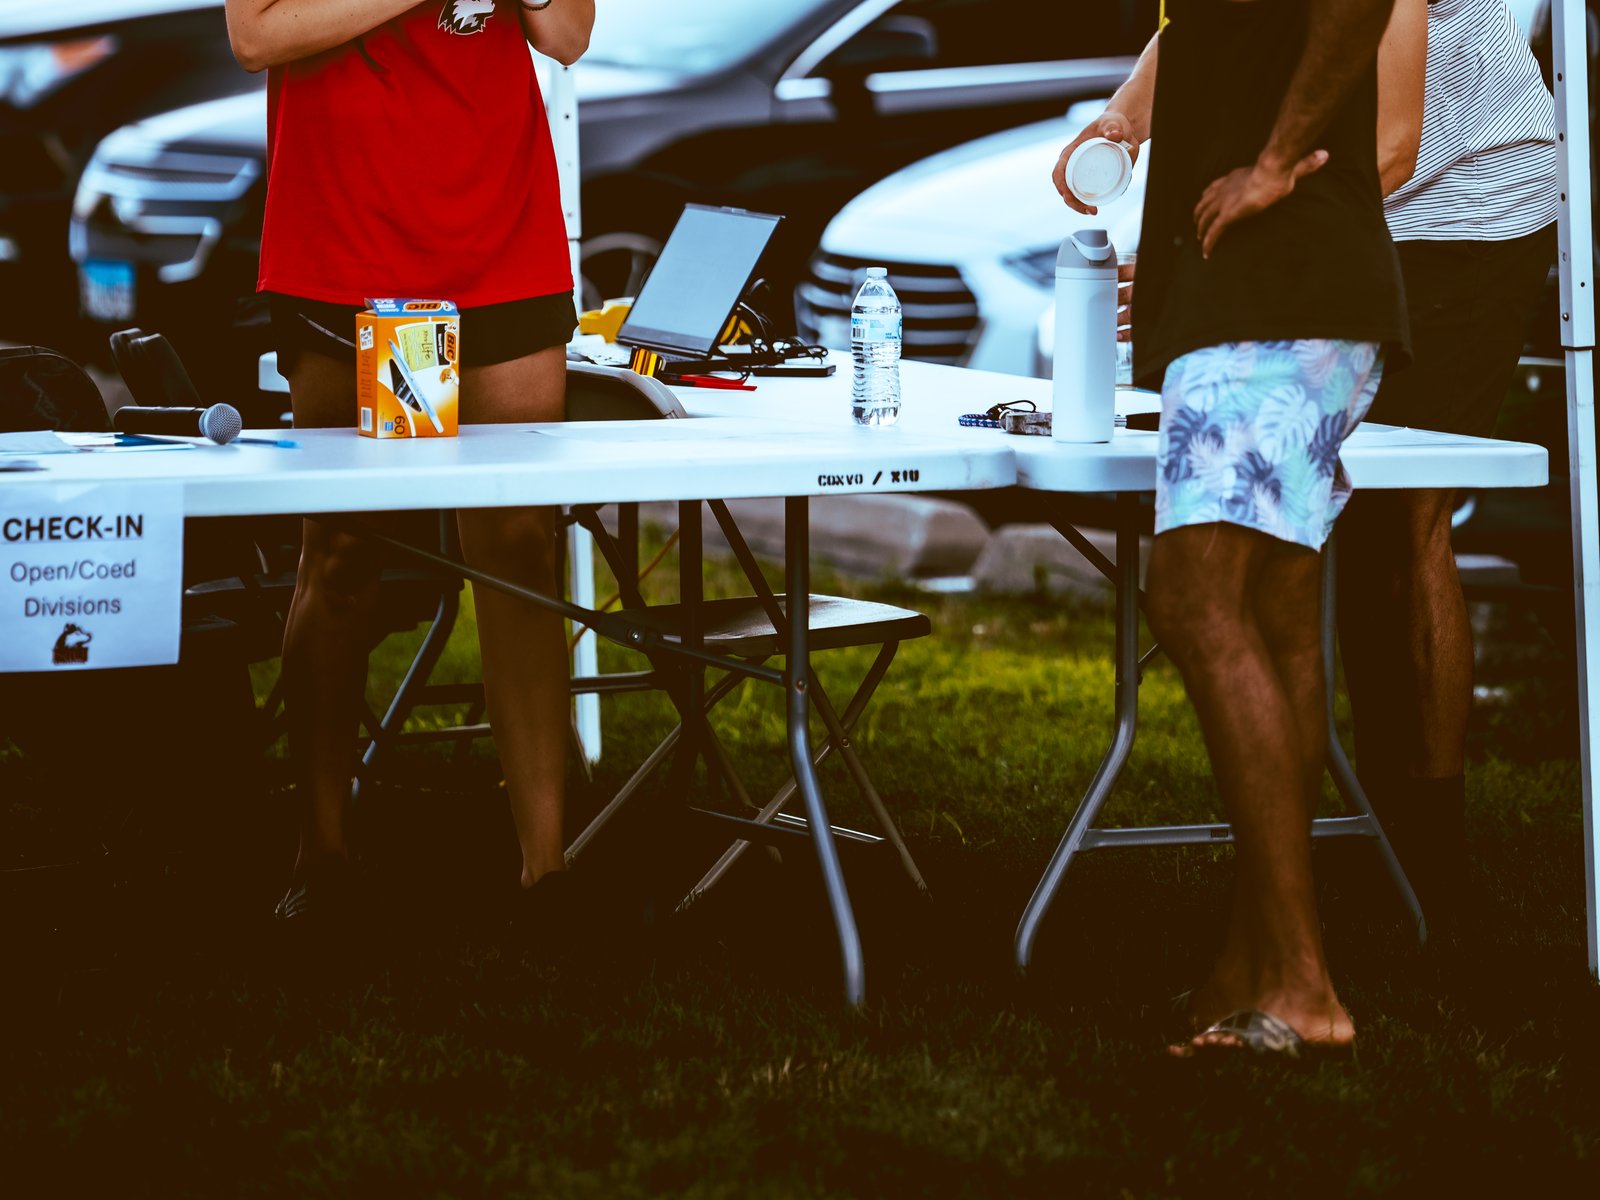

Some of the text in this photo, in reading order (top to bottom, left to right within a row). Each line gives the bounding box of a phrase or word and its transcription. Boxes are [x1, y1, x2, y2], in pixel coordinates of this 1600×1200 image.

[394, 415, 406, 435] 60
[873, 471, 882, 485] /
[2, 514, 143, 542] CHECK-IN
[10, 559, 136, 586] Open/Coed
[24, 596, 122, 618] Divisions
